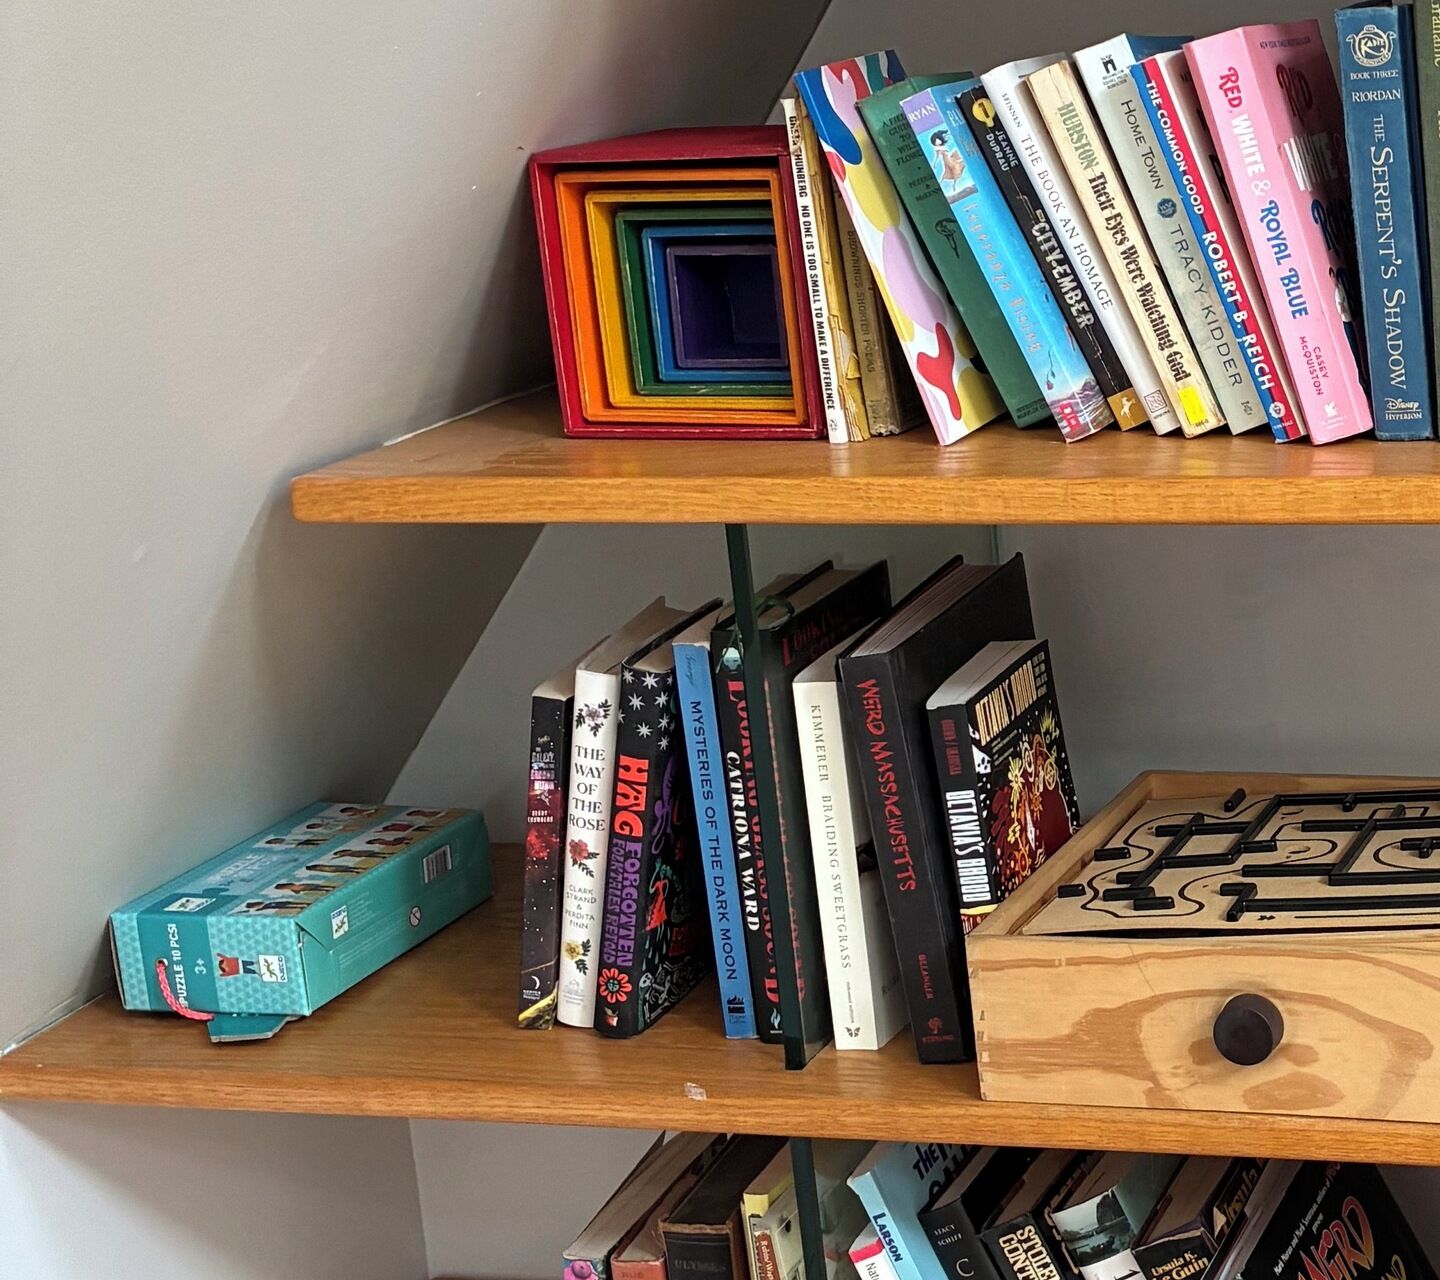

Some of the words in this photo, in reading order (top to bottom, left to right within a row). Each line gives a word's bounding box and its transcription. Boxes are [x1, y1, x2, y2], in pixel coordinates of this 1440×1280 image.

[1351, 90, 1400, 102] RIORDAN
[1230, 117, 1265, 176] WHITE
[1373, 114, 1385, 141] THE
[801, 205, 810, 217] NO
[1250, 179, 1271, 197] &
[1368, 144, 1397, 280] SERPENT'S
[803, 221, 813, 239] ONE
[805, 241, 814, 251] IS
[1020, 134, 1042, 168] THE
[1038, 168, 1065, 213] BOOK
[1062, 218, 1079, 240] AN
[1073, 243, 1113, 308] HOMAGE
[1057, 102, 1100, 170] HURSTON
[1088, 171, 1115, 212] Their
[1105, 211, 1128, 246] Eyes
[1120, 245, 1146, 282] Were
[1135, 283, 1177, 351] Watching
[1166, 348, 1191, 382] God
[1121, 100, 1146, 147] HOME
[1140, 147, 1164, 189] TOWN
[1170, 228, 1206, 295] TRACY
[1201, 307, 1242, 387] KIDDER
[1145, 80, 1165, 111] THE
[1157, 110, 1188, 171] COMMON
[1181, 169, 1204, 216] GOOD
[1202, 232, 1241, 302] ROBERT
[1232, 313, 1244, 330] B.
[1241, 332, 1275, 390] REICH
[1259, 199, 1292, 266] ROYAL
[807, 254, 817, 270] TOO
[810, 273, 820, 304] SMALL
[814, 307, 823, 318] TO
[1280, 268, 1308, 319] BLUE
[816, 321, 827, 344] MAKE
[1383, 289, 1407, 390] SHADOW
[820, 355, 835, 409] DIFFERENCE
[1313, 346, 1328, 379] CASEY
[856, 679, 885, 736] WEIRD
[573, 764, 606, 779] WAY
[576, 745, 605, 762] THE
[690, 700, 714, 800] MYSTERIES
[573, 799, 603, 815] THE
[577, 782, 597, 795] OF
[613, 753, 649, 839] HAG
[705, 805, 718, 820] OF
[569, 814, 605, 831] ROSE
[811, 704, 829, 782] KIMMERER
[822, 796, 840, 870] BRAIDING
[832, 875, 852, 969] SWEETGRASS
[870, 740, 918, 891] MASSACHUSETTS
[945, 790, 984, 856] OCTAVIA'S
[707, 825, 721, 859] THE
[727, 751, 750, 857] CATRIONA
[740, 861, 759, 931] WARD
[713, 864, 730, 921] DARK
[957, 857, 991, 904] BROOD
[719, 929, 737, 980] MOON
[872, 1213, 903, 1263] LARSON
